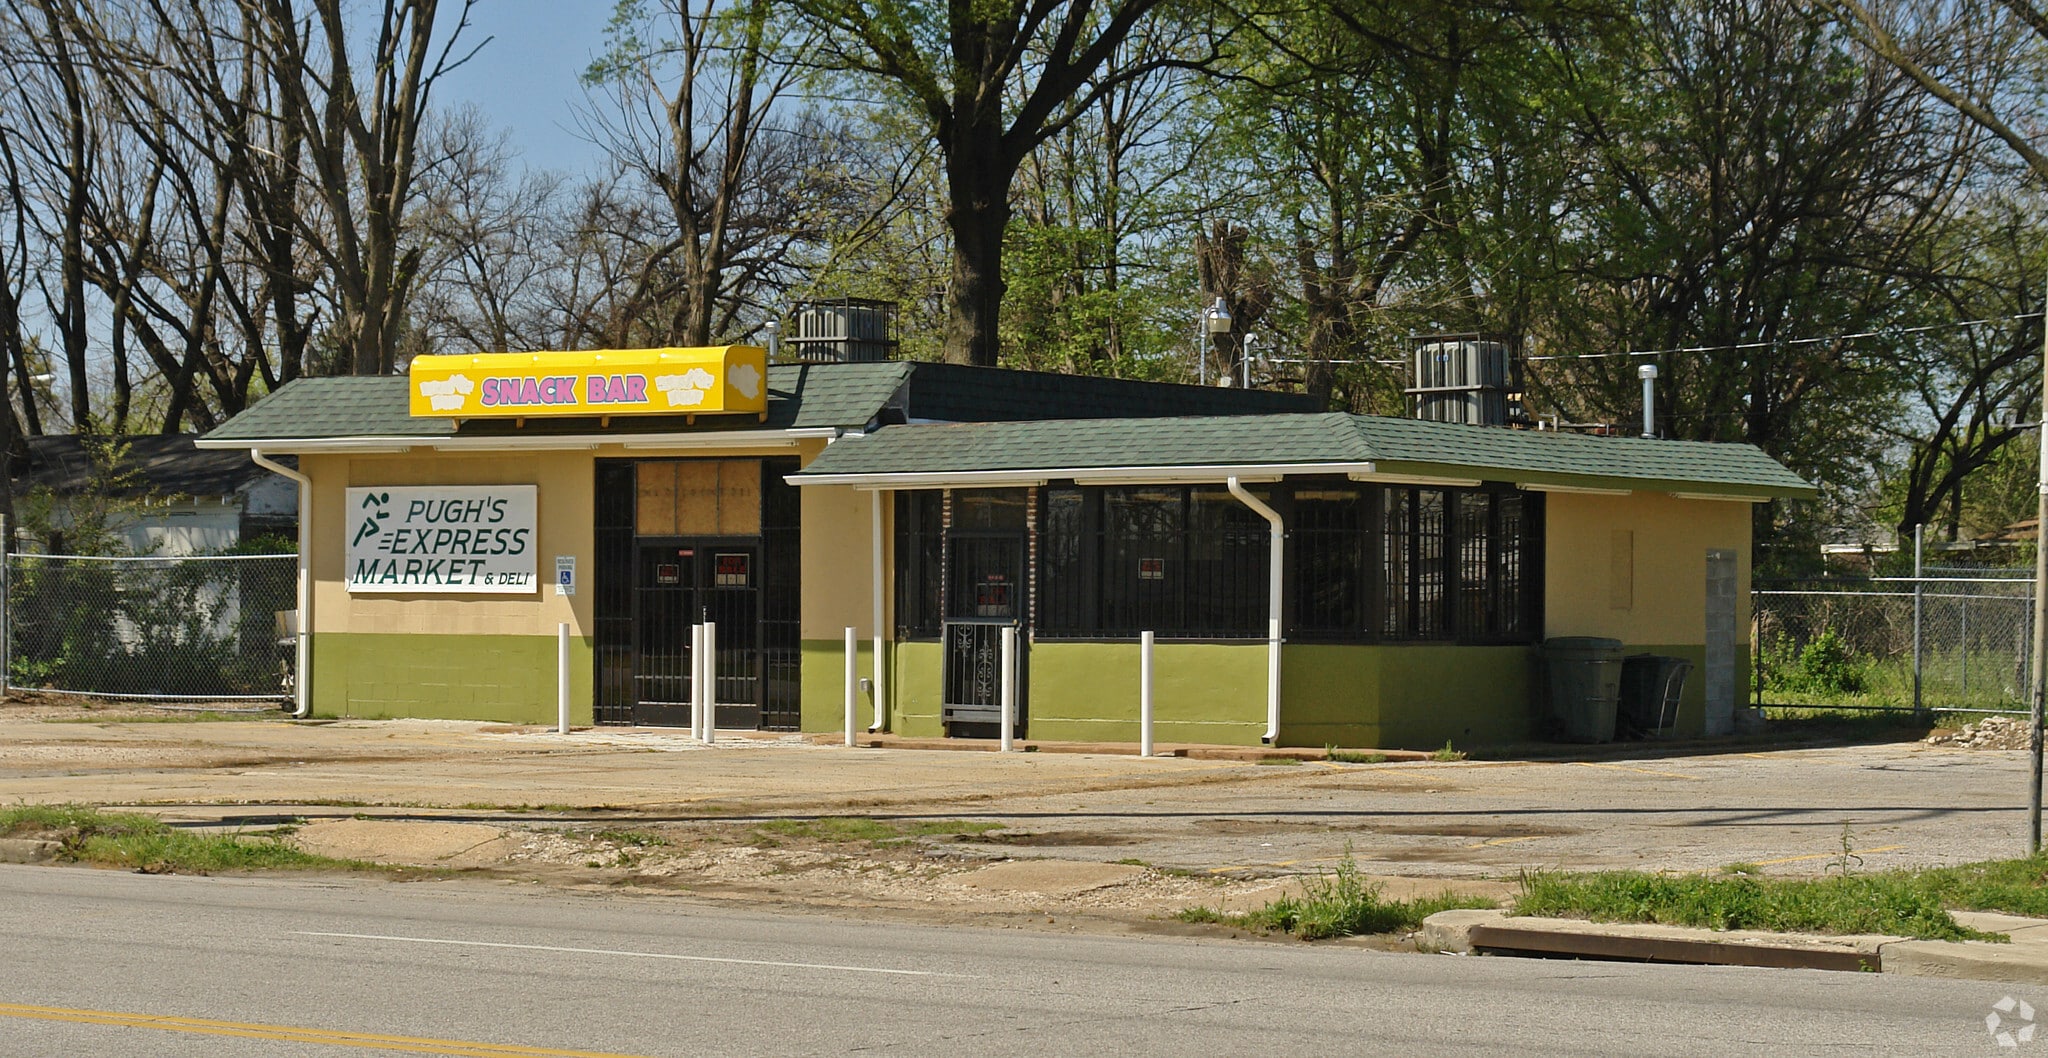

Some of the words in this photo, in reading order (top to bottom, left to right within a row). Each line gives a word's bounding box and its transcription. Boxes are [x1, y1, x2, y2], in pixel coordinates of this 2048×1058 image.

[481, 377, 578, 406] SNACK
[587, 375, 649, 404] BAR
[405, 496, 508, 523] PUGH'S
[390, 529, 529, 555] EXPRESS
[353, 559, 485, 585] MARKET
[484, 573, 494, 585] &
[498, 573, 529, 585] DELI
